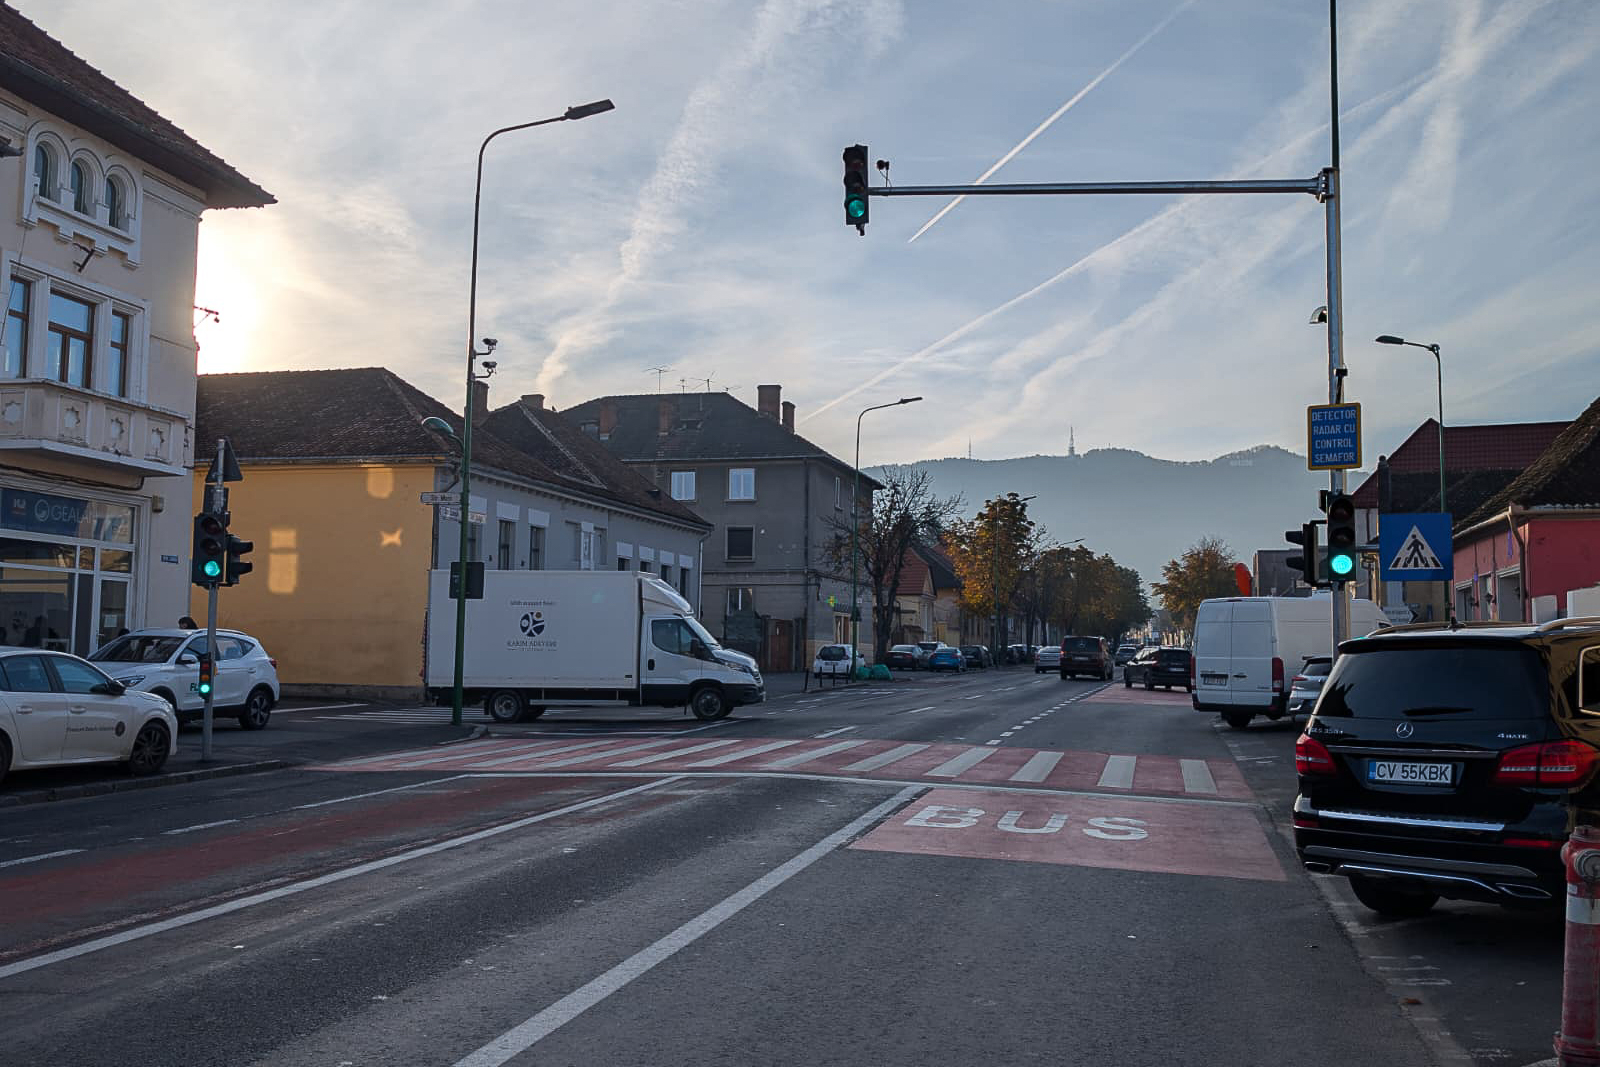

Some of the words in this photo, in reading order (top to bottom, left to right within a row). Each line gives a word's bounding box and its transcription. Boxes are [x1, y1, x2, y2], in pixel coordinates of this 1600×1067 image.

[1312, 410, 1356, 421] DETECTOR
[1313, 424, 1341, 435] RADAR
[1344, 423, 1356, 433] CU
[1315, 438, 1353, 449] CONTROL
[1315, 452, 1355, 462] SEMAFOR
[1377, 763, 1397, 778] CV
[1401, 764, 1449, 781] 55KBK
[904, 805, 1148, 841] BUS
